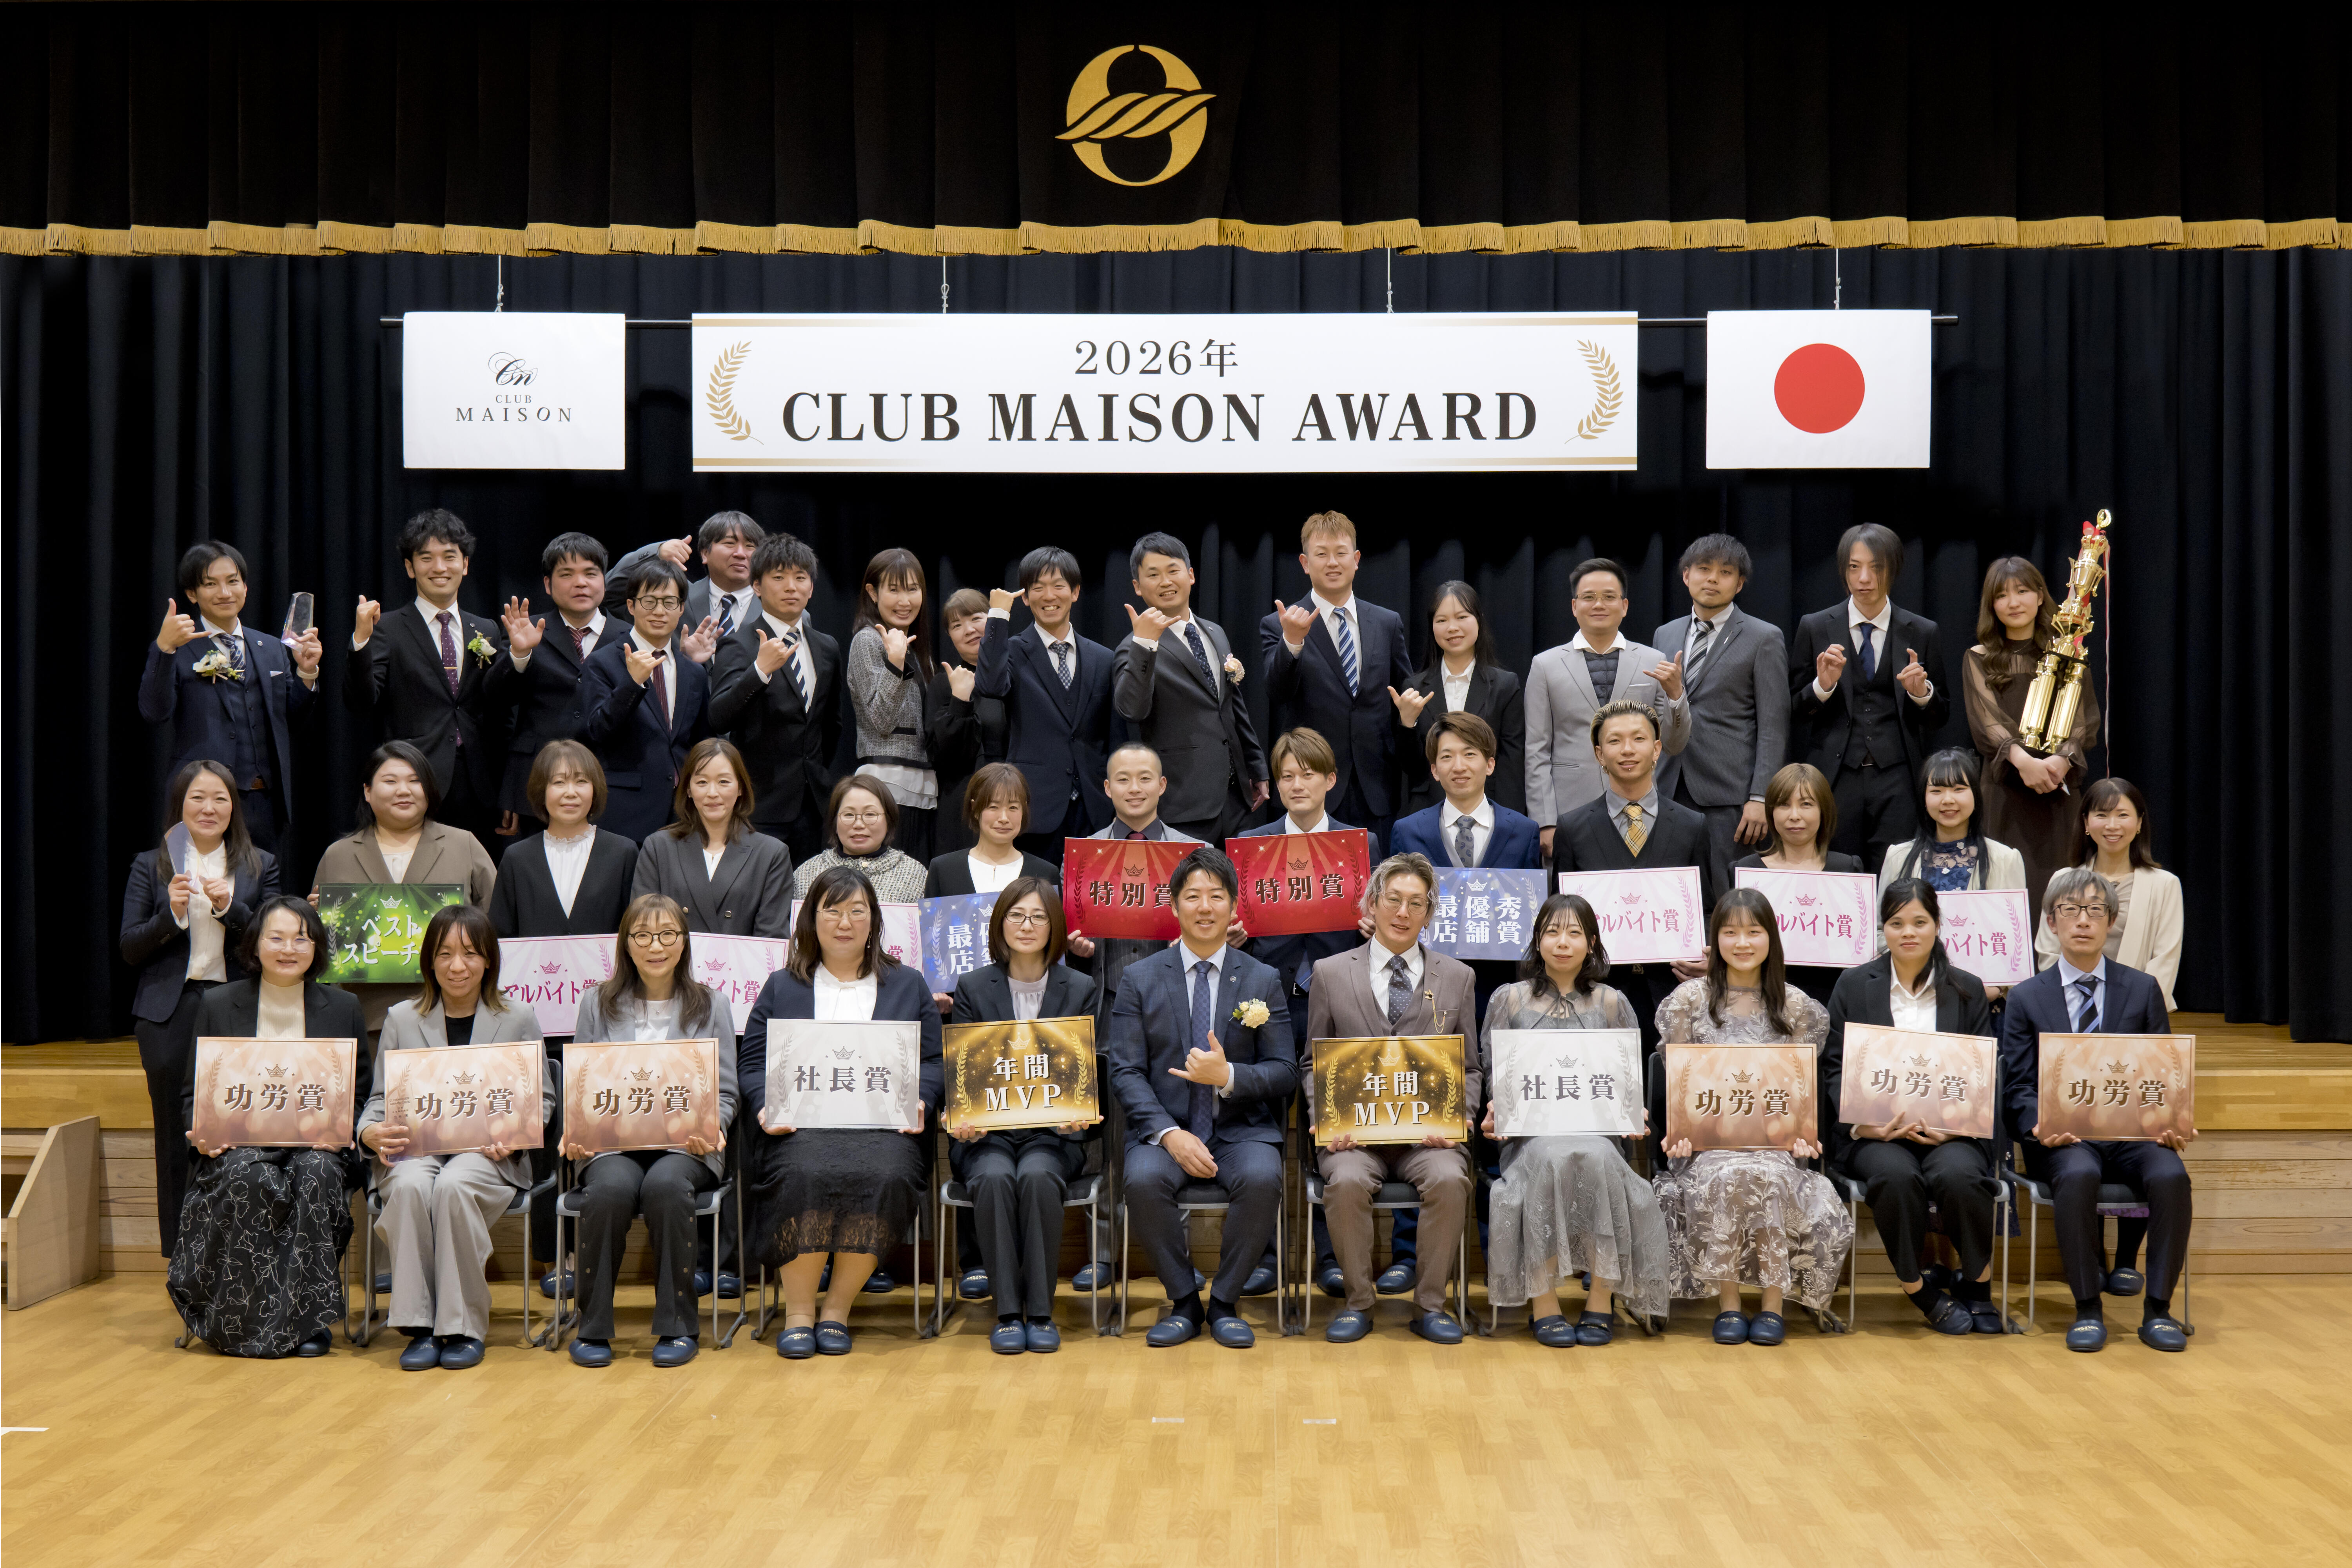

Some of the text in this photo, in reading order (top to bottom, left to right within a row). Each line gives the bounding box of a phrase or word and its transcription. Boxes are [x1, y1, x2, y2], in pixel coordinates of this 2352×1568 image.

[1075, 339, 1238, 377] 2026年
[496, 395, 532, 403] CLUB
[456, 407, 571, 422] MAISON
[783, 392, 1537, 443] CLUB MAISON AWARD
[1089, 881, 1172, 908] 特別賞
[1255, 873, 1345, 904] 特別賞
[1435, 895, 1522, 920] 最優秀
[1595, 909, 1679, 933] ルバイト賞
[361, 915, 418, 938] ベスト
[1433, 920, 1522, 945] 店舗賞
[793, 1065, 892, 1094] 社長賞
[993, 1053, 1051, 1082] 年間
[1363, 1070, 1419, 1097] 年間
[1520, 1074, 1615, 1101] 社長賞
[1871, 1067, 1969, 1103] 功労賞
[2068, 1079, 2167, 1109] 功労賞
[224, 1083, 327, 1112] 功労賞
[415, 1087, 515, 1121] 功労賞
[593, 1085, 691, 1116] 功労賞
[985, 1084, 1062, 1111] MVP
[1695, 1089, 1791, 1117] 功労賞
[1354, 1101, 1430, 1126] MVP
